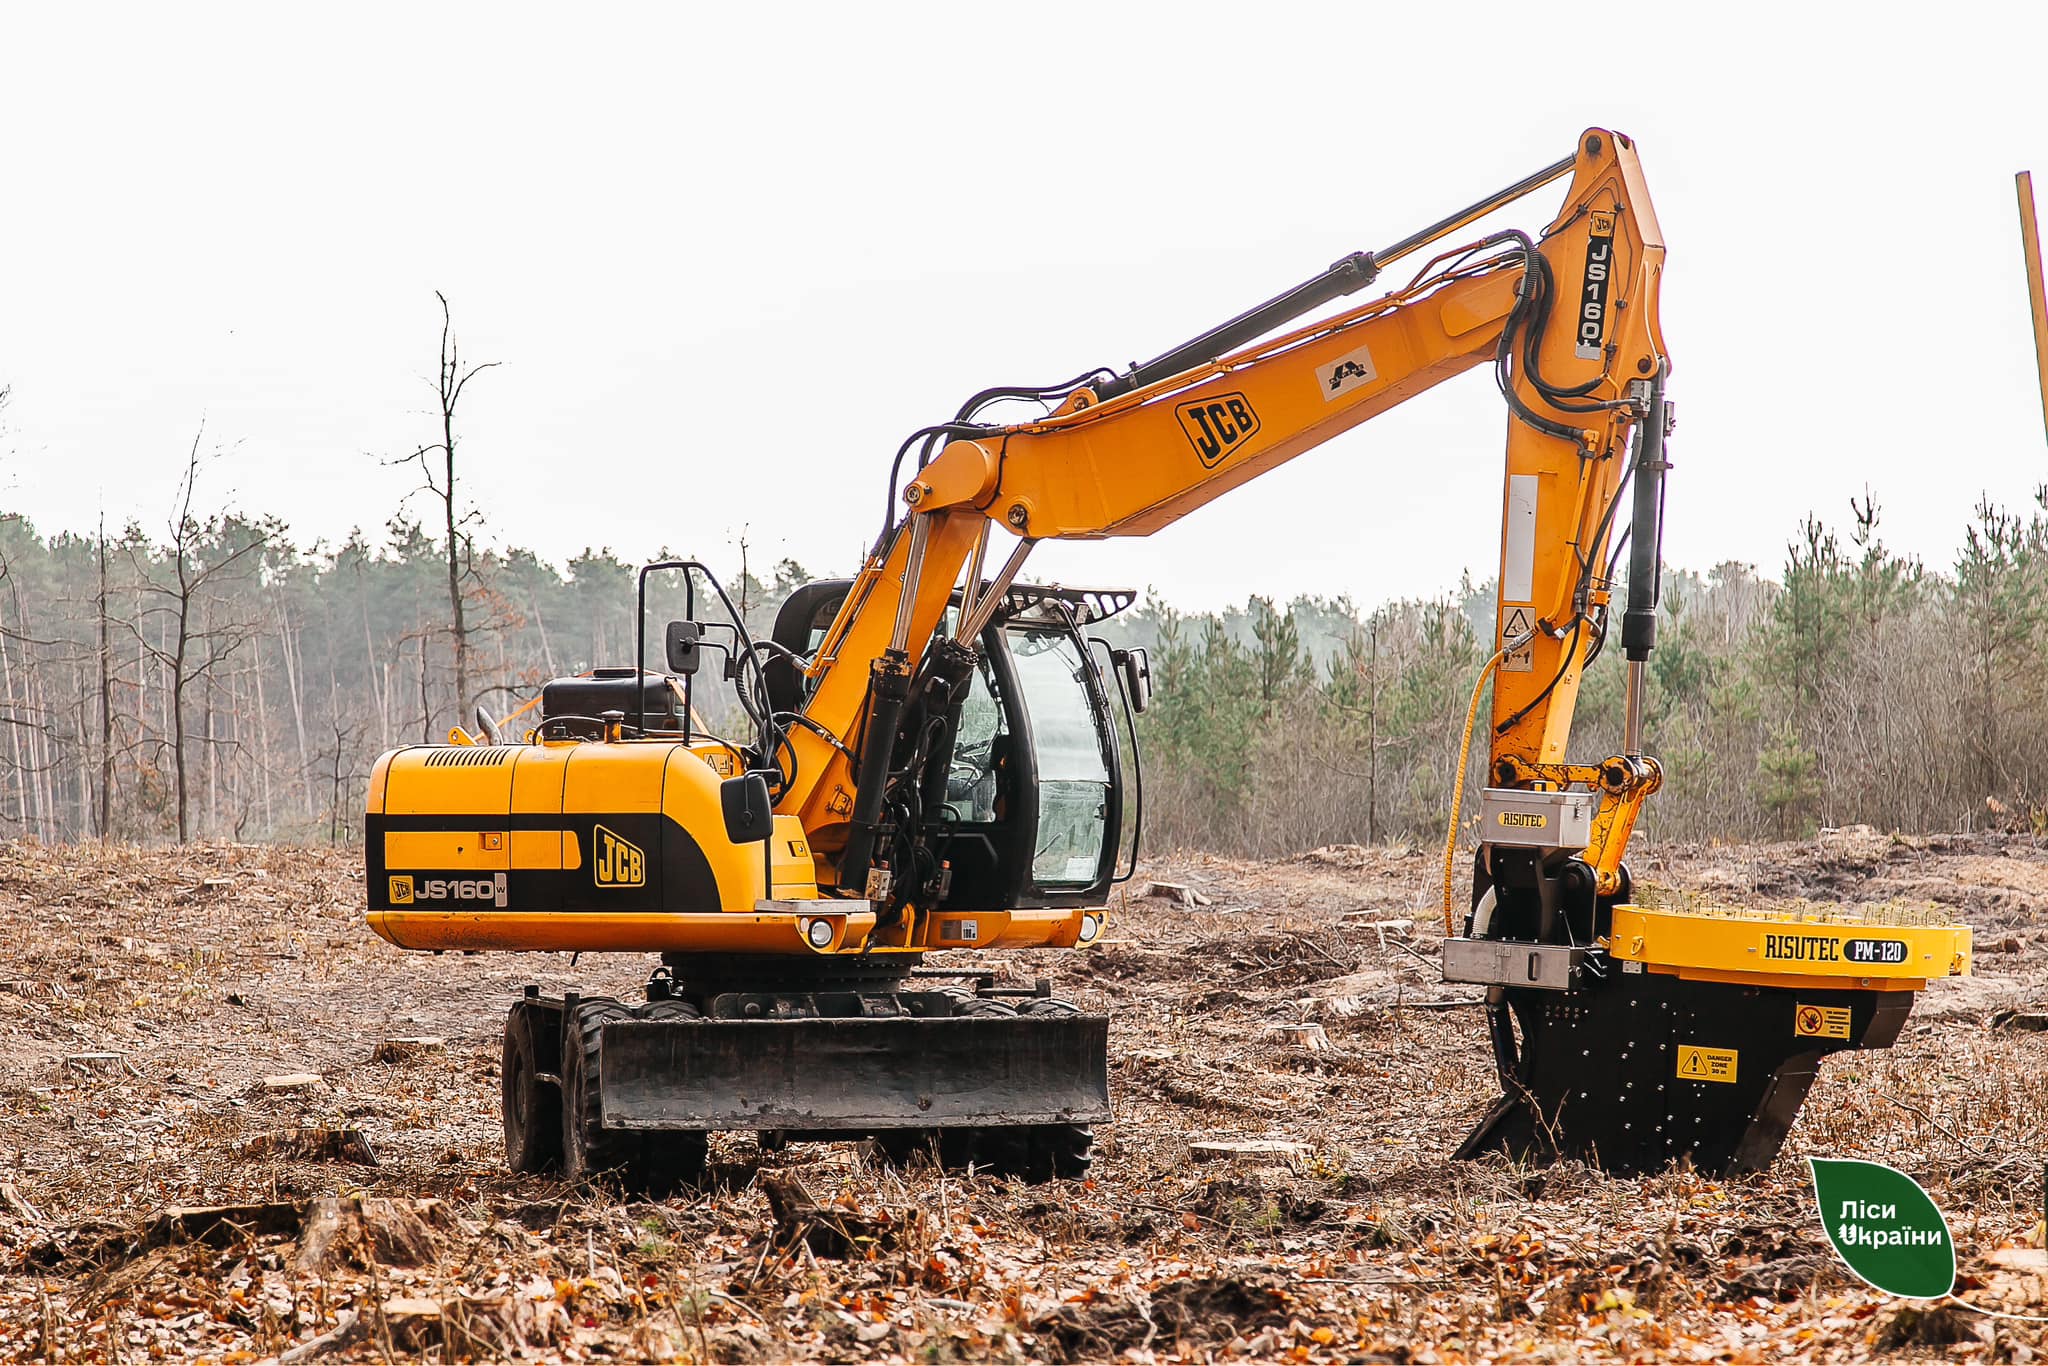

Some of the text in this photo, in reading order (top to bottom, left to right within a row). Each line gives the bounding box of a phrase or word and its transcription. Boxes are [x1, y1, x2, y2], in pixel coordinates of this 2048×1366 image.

[1581, 244, 1608, 340] JS160
[1187, 399, 1253, 460] JCB
[1503, 812, 1542, 828] RISUTEC
[599, 833, 641, 882] JCB
[394, 881, 410, 900] JCB
[415, 880, 494, 899] JS160
[1765, 935, 1902, 961] RISUTEC PM-120
